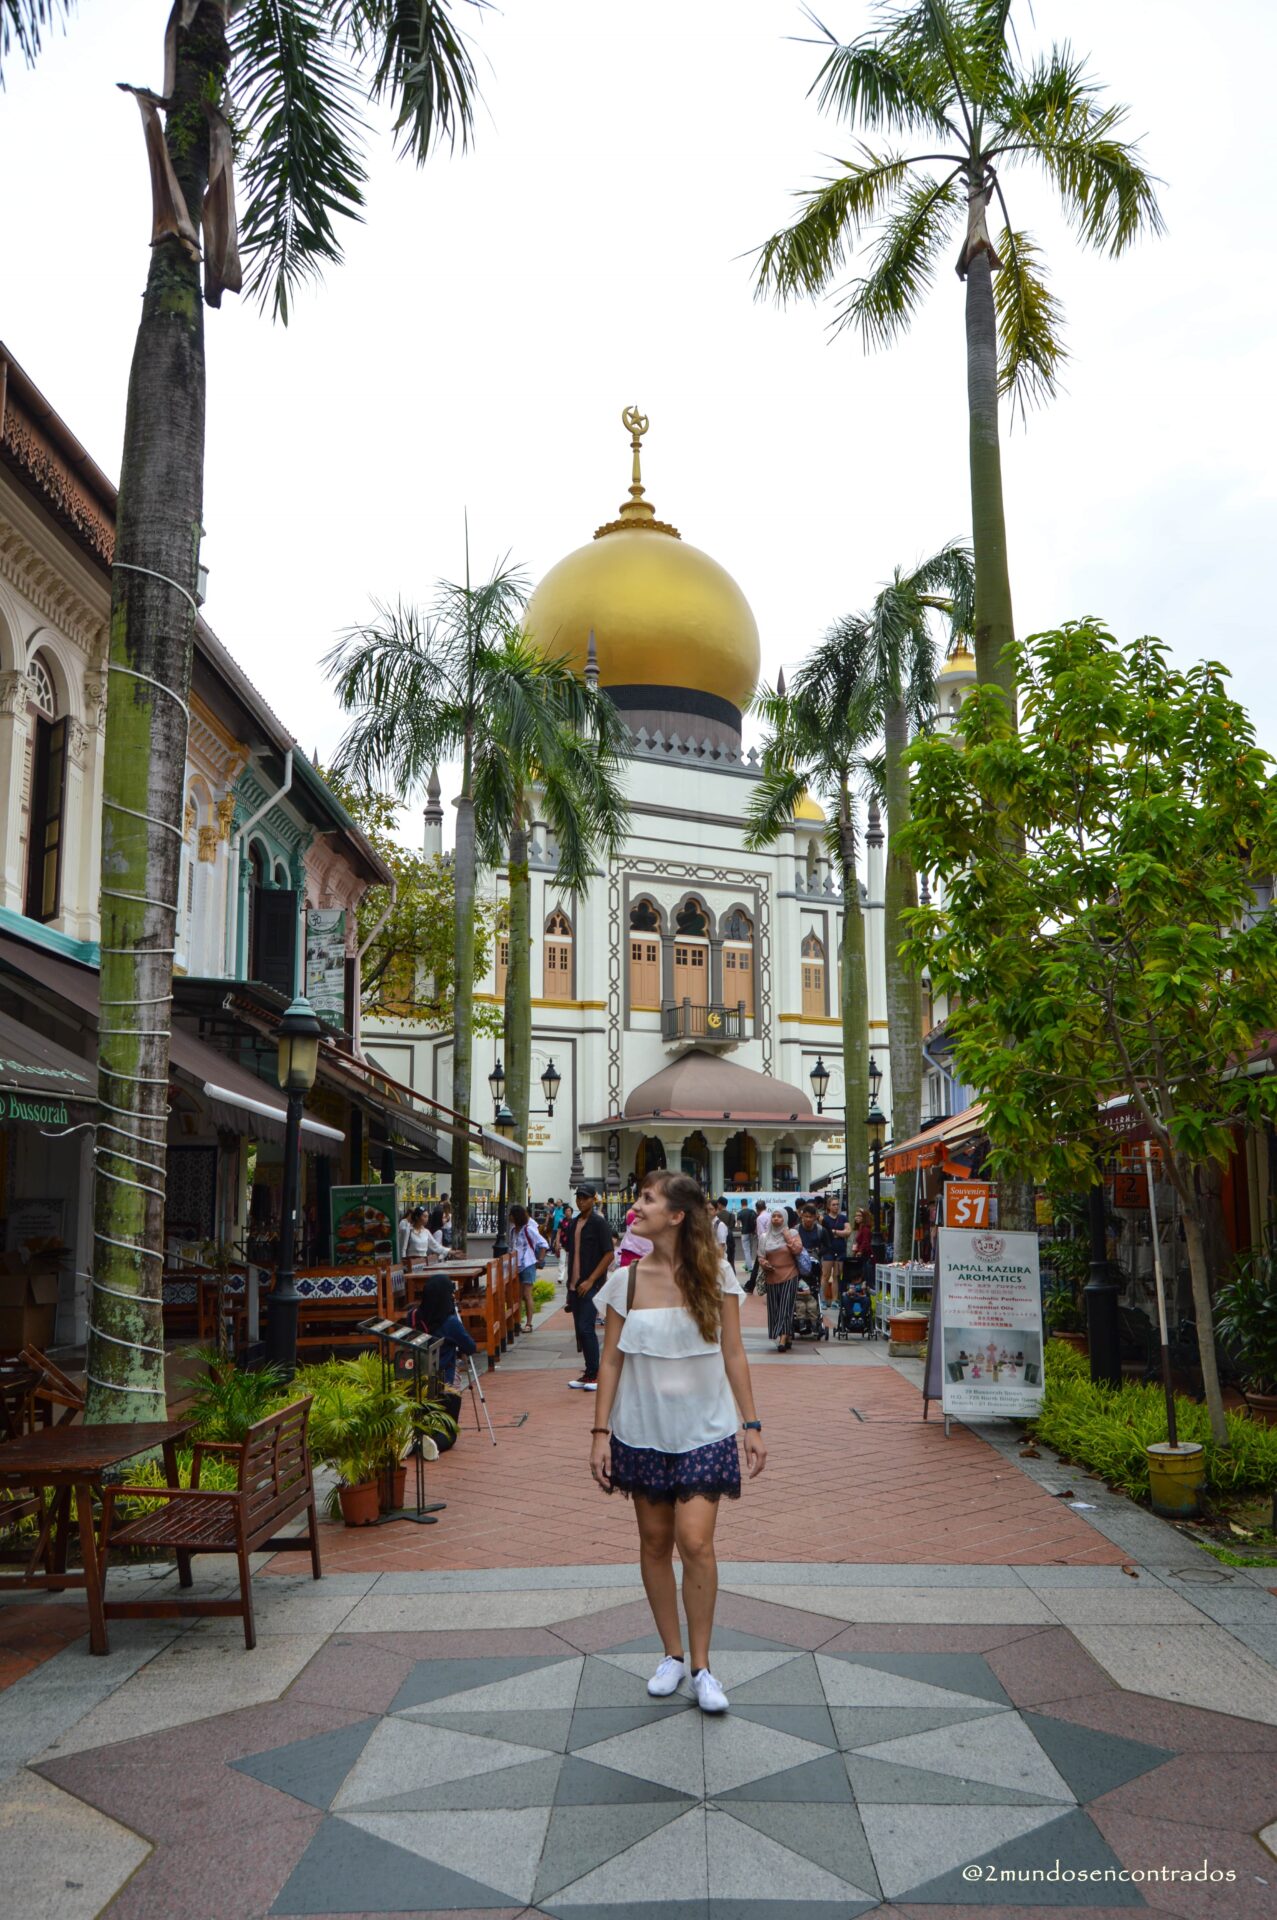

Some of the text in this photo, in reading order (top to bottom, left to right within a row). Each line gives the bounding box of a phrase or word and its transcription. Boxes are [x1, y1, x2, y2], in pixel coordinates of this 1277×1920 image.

[8, 1094, 68, 1124] Bussorah
[950, 1186, 987, 1196] Souvenirs
[954, 1195, 987, 1225] $1
[947, 1263, 1032, 1274] JAMAL KAZURA
[958, 1273, 1022, 1283] AROMATICS
